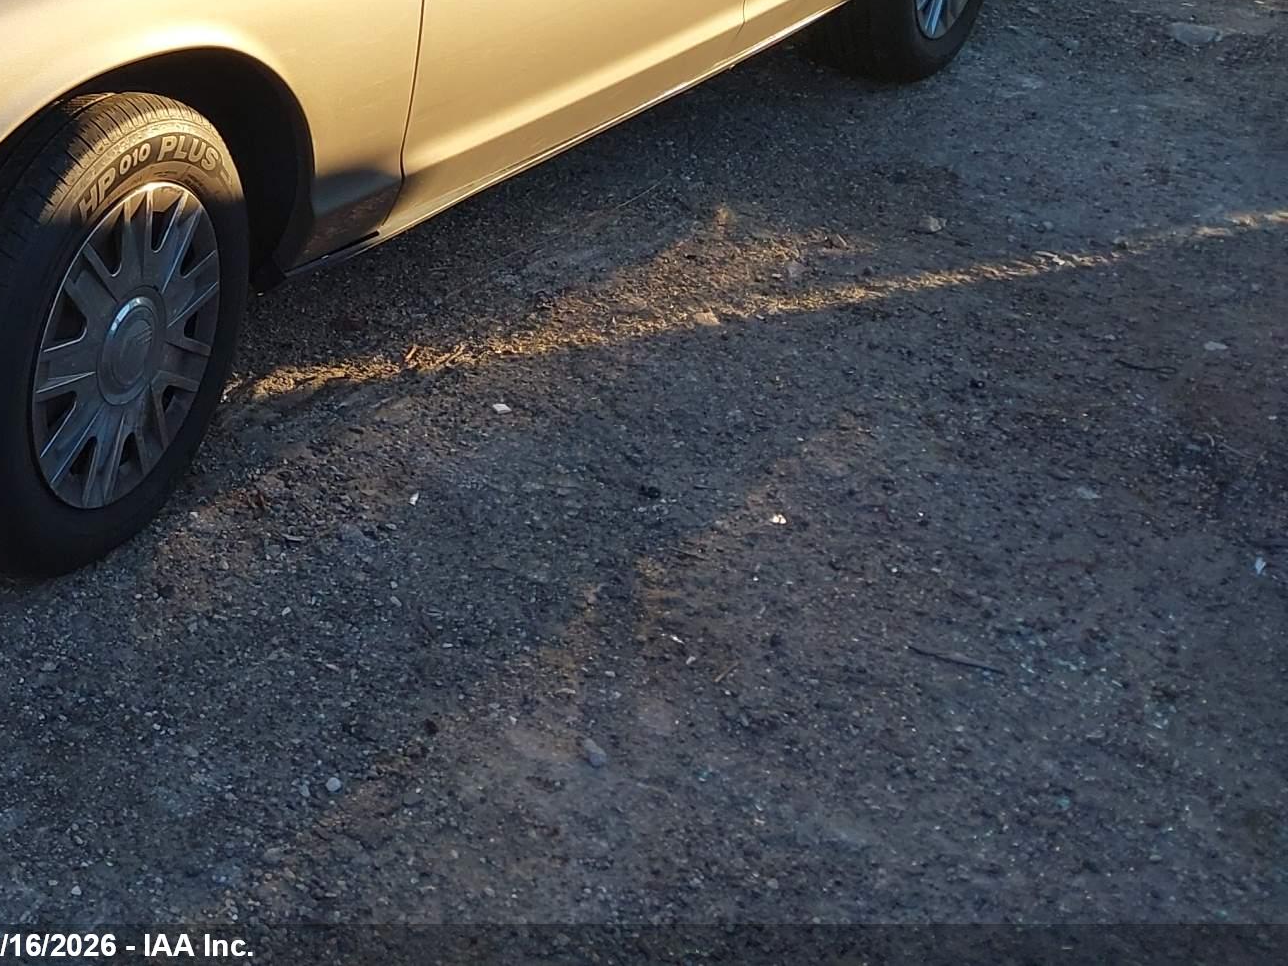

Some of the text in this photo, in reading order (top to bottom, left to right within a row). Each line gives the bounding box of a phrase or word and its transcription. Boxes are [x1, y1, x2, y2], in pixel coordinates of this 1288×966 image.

[78, 135, 219, 221] HP 010 PLUS
